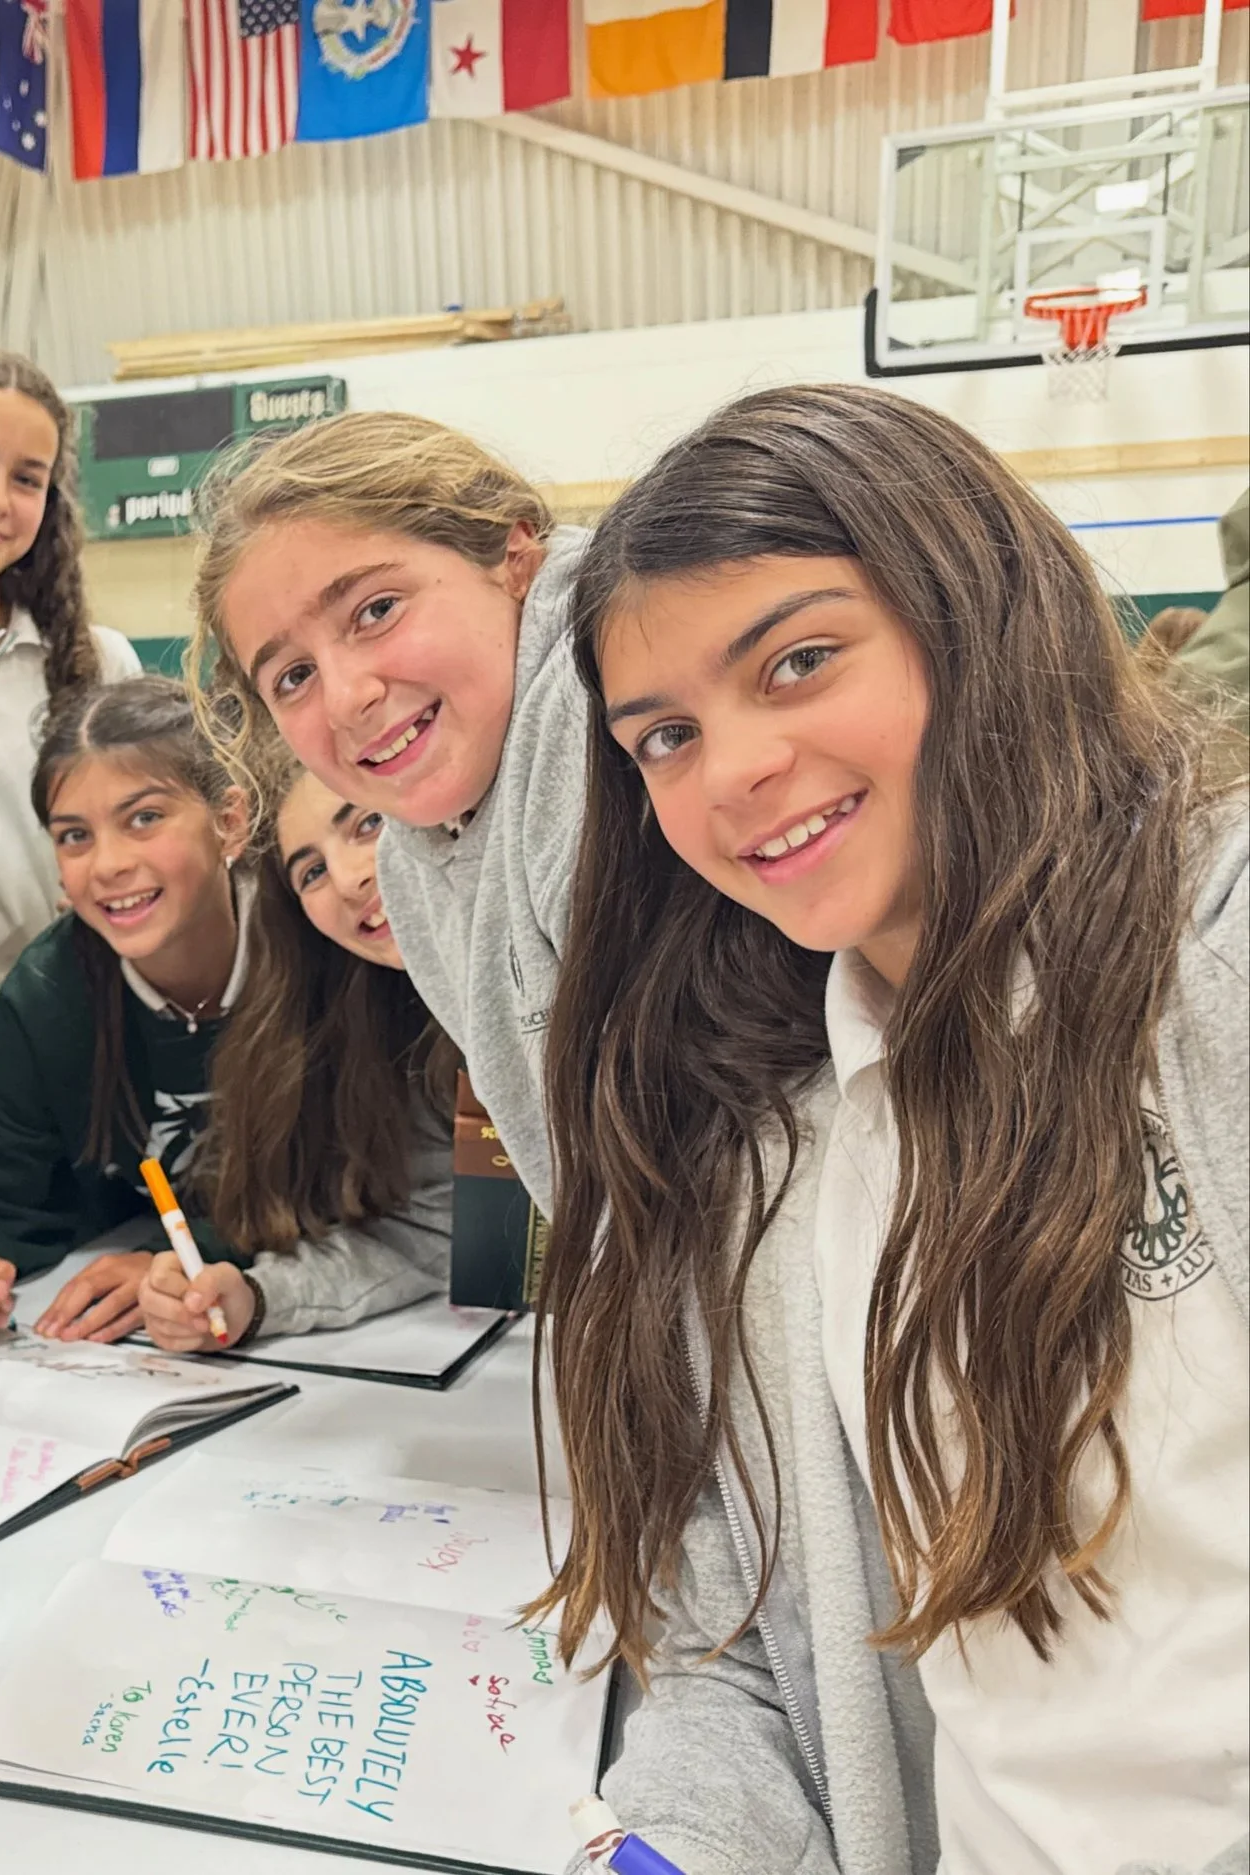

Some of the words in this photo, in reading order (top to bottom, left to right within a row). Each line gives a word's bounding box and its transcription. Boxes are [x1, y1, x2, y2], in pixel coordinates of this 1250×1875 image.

[1122, 1263, 1152, 1293] TAS
[204, 1671, 269, 1770] EVER!
[253, 1662, 318, 1776] PERSON
[317, 1670, 362, 1729] THE
[348, 1650, 433, 1822] ABSOLUTELY
[297, 1738, 350, 1806] BEST
